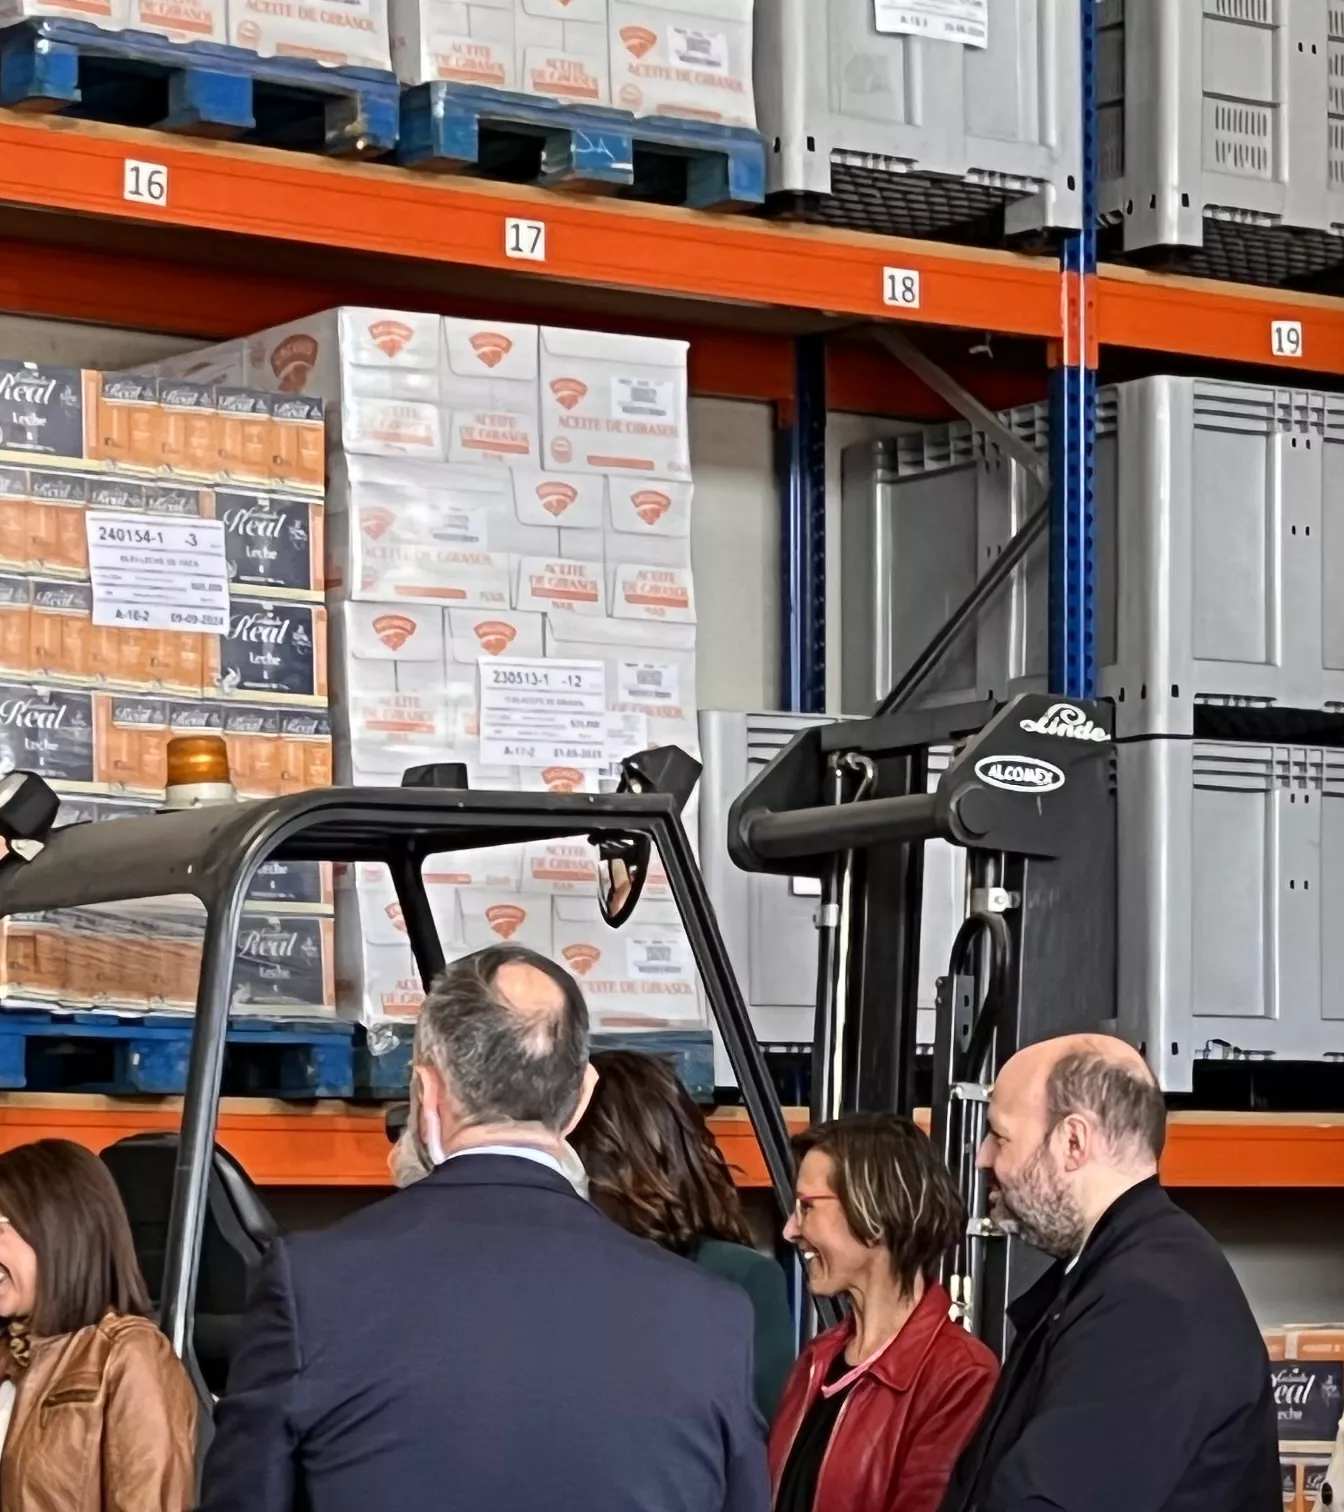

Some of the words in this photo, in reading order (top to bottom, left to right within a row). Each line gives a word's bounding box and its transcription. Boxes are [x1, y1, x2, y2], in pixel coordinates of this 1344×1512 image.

[128, 165, 164, 199] 16
[510, 223, 542, 253] 17
[886, 274, 914, 302] 18
[1274, 326, 1301, 354] 19
[225, 503, 287, 538] Real
[99, 527, 163, 544] 240154-1
[228, 611, 291, 643] Real
[249, 651, 282, 666] Leche
[1020, 703, 1111, 742] Linde
[582, 980, 618, 994] CEITE
